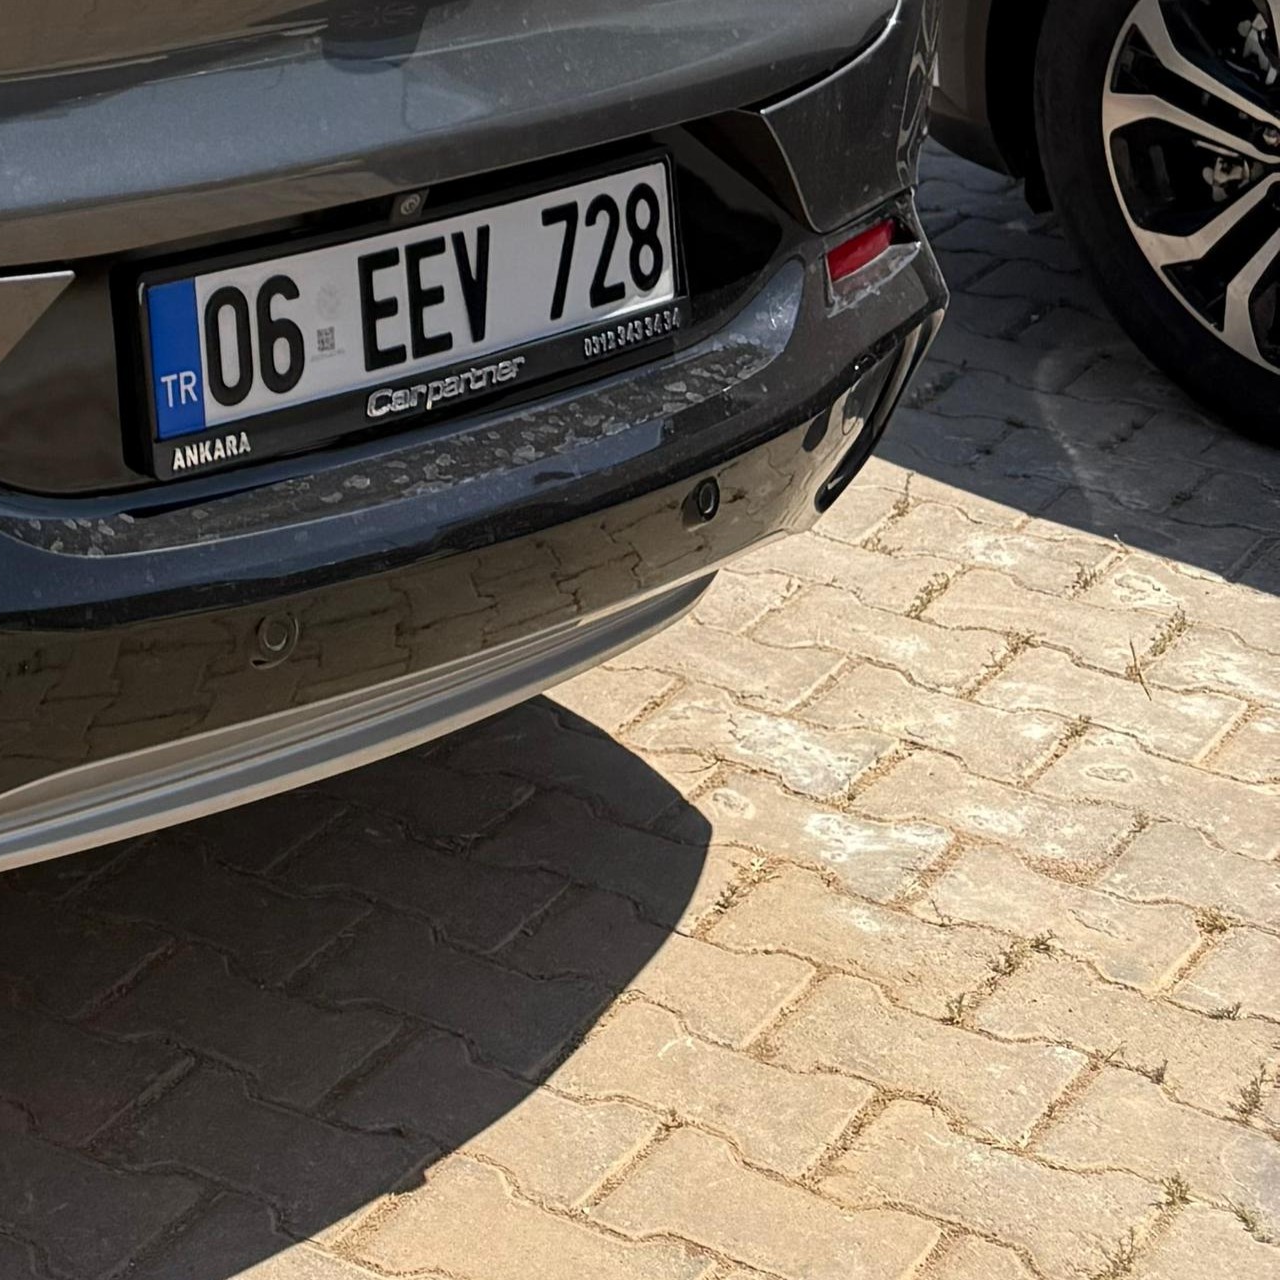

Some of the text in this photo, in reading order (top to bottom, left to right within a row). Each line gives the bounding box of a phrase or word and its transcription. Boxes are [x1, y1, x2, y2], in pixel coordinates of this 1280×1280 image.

[205, 182, 661, 407] 06 EEV 728
[160, 370, 198, 408] TR
[172, 431, 251, 471] ANKARA
